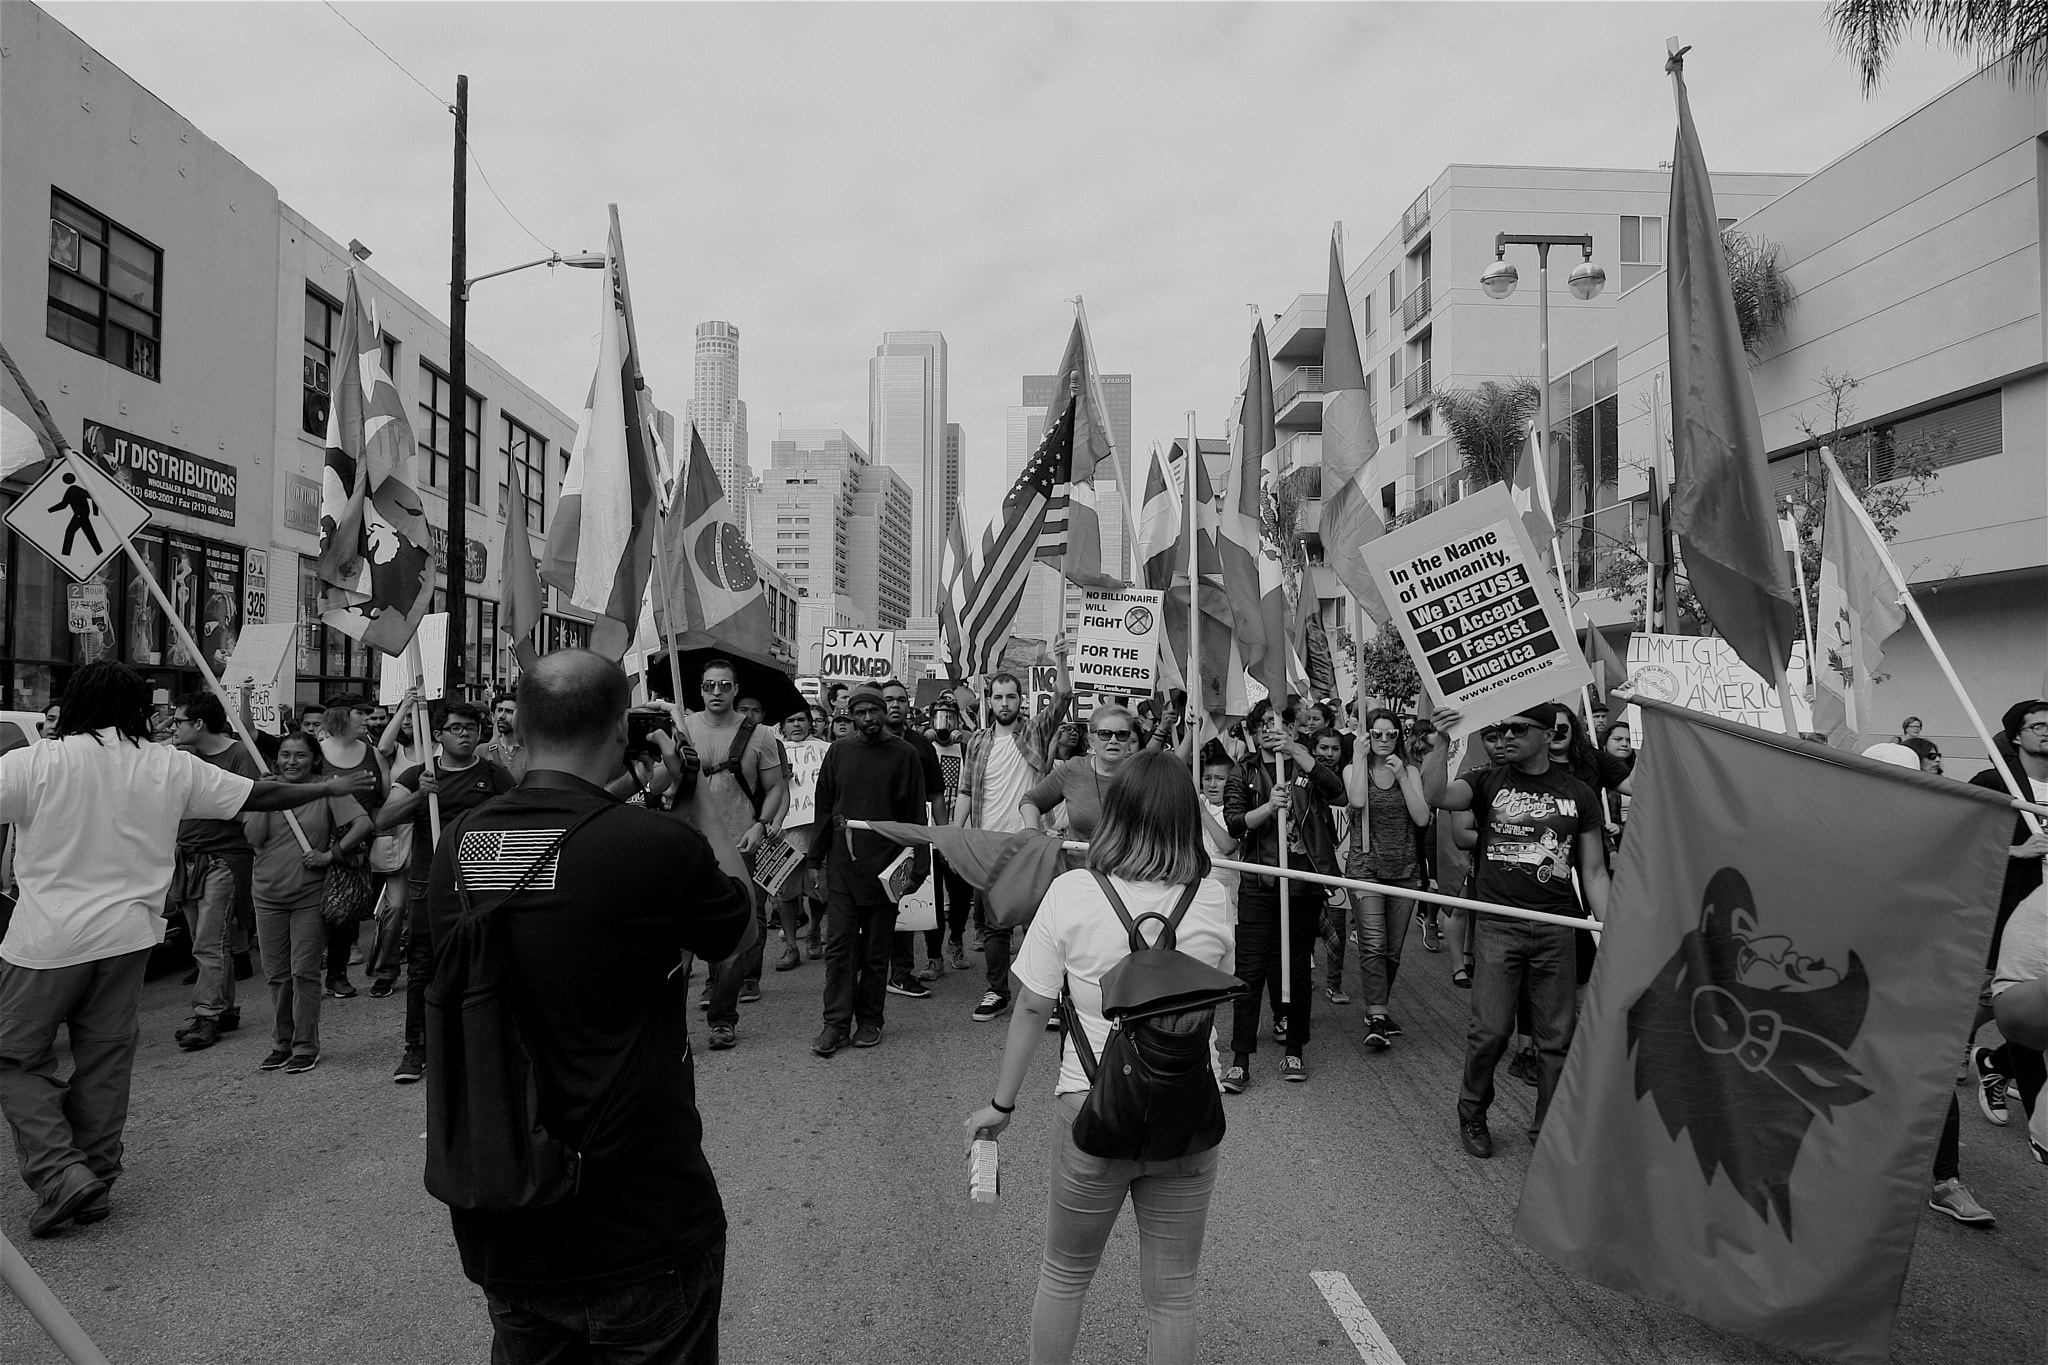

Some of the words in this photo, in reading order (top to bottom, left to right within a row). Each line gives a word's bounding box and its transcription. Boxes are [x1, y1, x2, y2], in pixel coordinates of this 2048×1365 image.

[131, 442, 236, 497] DISTRIBUTORS
[147, 477, 181, 495] WHOLESALER
[182, 487, 187, 496] &
[187, 489, 217, 504] DISTRIBUTOR
[143, 488, 174, 505] 680-2002
[179, 498, 191, 509] Fax
[191, 501, 207, 515] (213)
[207, 505, 234, 520] 680-2003
[248, 553, 265, 576] JT
[1389, 568, 1410, 586] In
[1411, 557, 1442, 576] the
[1443, 531, 1497, 562] Name
[1399, 583, 1418, 604] of
[1420, 549, 1511, 595] Humanity,
[72, 586, 80, 597] 2
[1086, 591, 1099, 600] NO
[1101, 592, 1158, 604] BILLIONAIRE
[1412, 603, 1444, 626] We
[1443, 568, 1523, 615] REFUSE
[247, 590, 266, 618] 326
[1085, 603, 1107, 612] WILL
[1083, 616, 1123, 629] FIGHT
[1431, 625, 1456, 644] To
[1460, 595, 1523, 634] Accept
[825, 629, 885, 652] STAY
[1447, 650, 1461, 664] a
[1461, 618, 1530, 658] Fascist
[1081, 644, 1109, 658] FOR
[1112, 647, 1139, 661] THE
[1461, 643, 1536, 684] America
[1627, 637, 1805, 670] IMMIGRS
[823, 652, 892, 677] OUTRAGED
[1080, 662, 1150, 680] WORKERS
[1684, 664, 1742, 686] MAKE
[1093, 684, 1131, 695] PSLweb.org
[1459, 659, 1553, 702] www.revcom.us
[1491, 787, 1539, 807] Cheech
[1540, 792, 1555, 804] &
[1506, 800, 1555, 818] Chong
[757, 860, 775, 881] Estados
[769, 856, 788, 878] fascista
